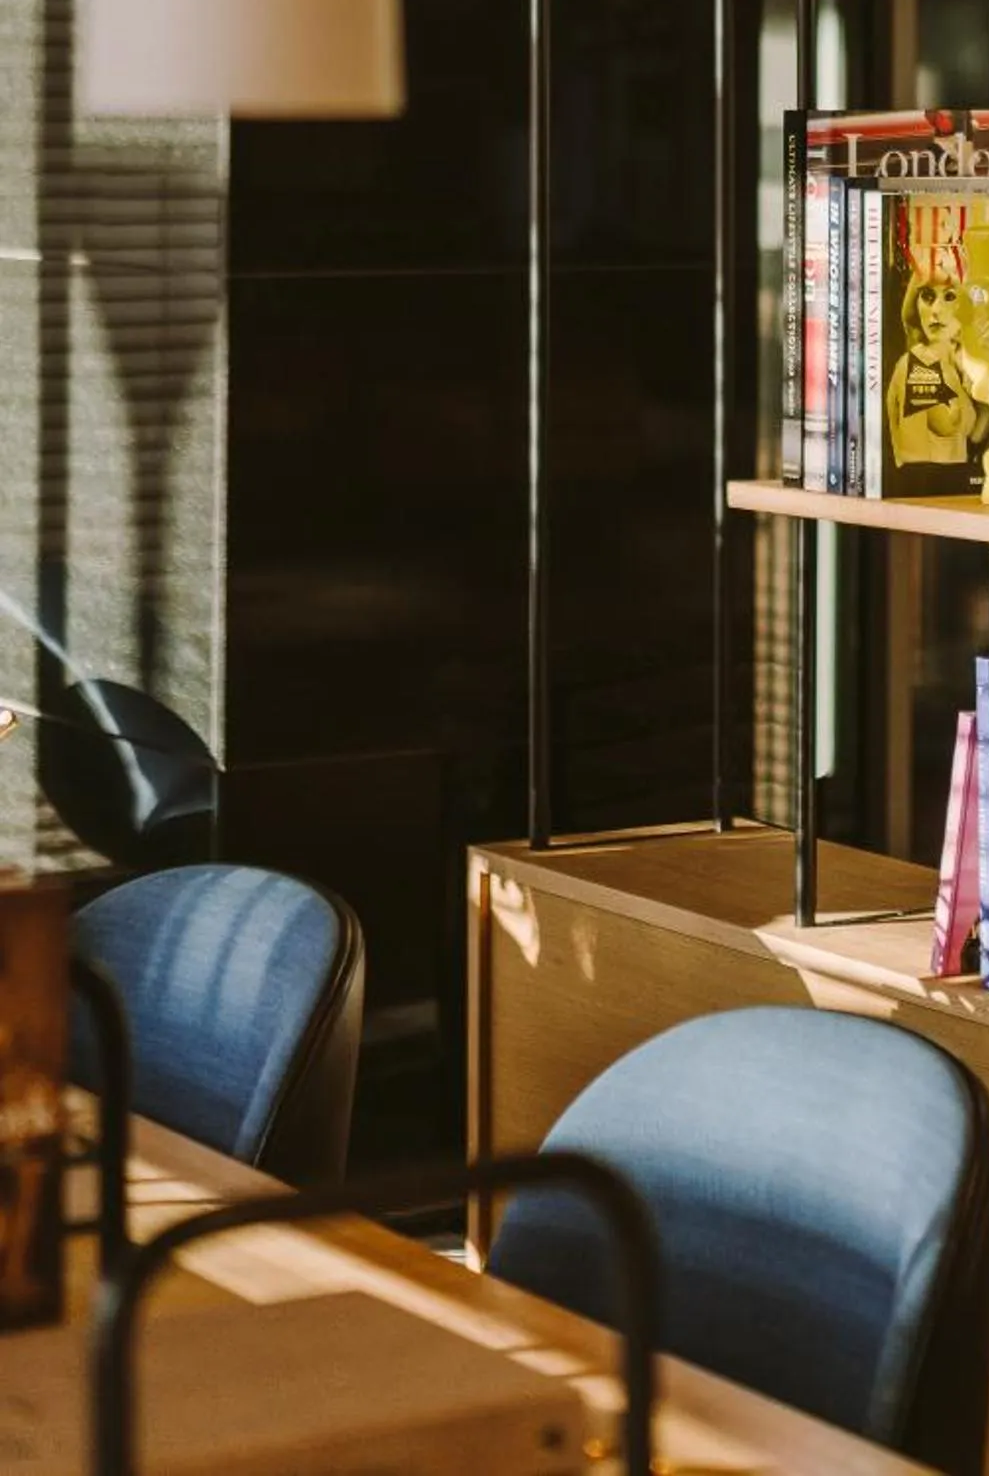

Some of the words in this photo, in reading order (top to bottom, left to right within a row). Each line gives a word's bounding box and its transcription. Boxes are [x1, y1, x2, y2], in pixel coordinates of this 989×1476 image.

[829, 229, 839, 307] WHOSE
[869, 208, 877, 297] HELMUT
[869, 306, 879, 392] NEWTON
